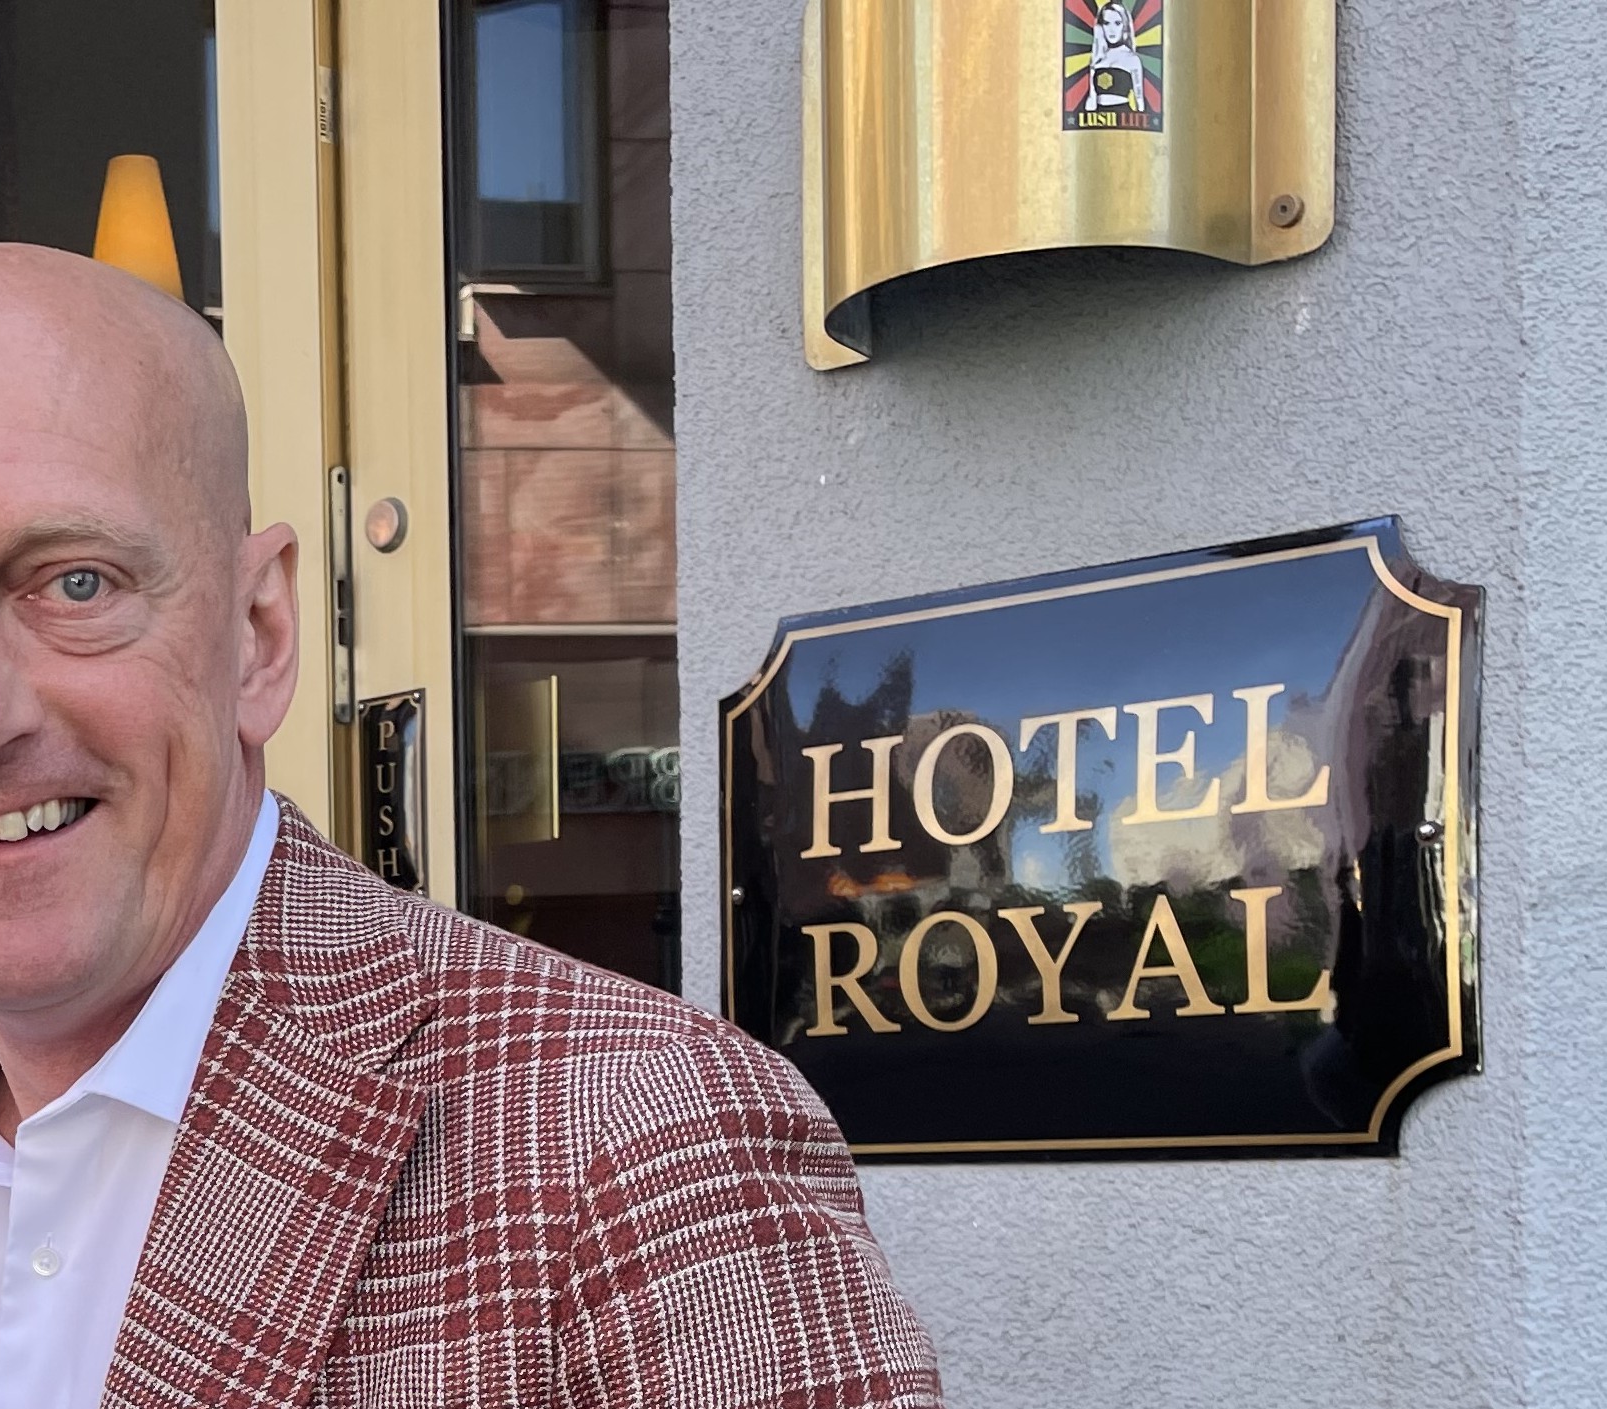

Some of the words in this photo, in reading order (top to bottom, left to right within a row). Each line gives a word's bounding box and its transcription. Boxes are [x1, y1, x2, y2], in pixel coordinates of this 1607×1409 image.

[1078, 111, 1117, 127] LUSH
[1121, 111, 1150, 128] LIFE
[376, 720, 400, 879] PUSH
[800, 682, 1330, 859] HOTEL
[802, 886, 1331, 1037] ROYAL
